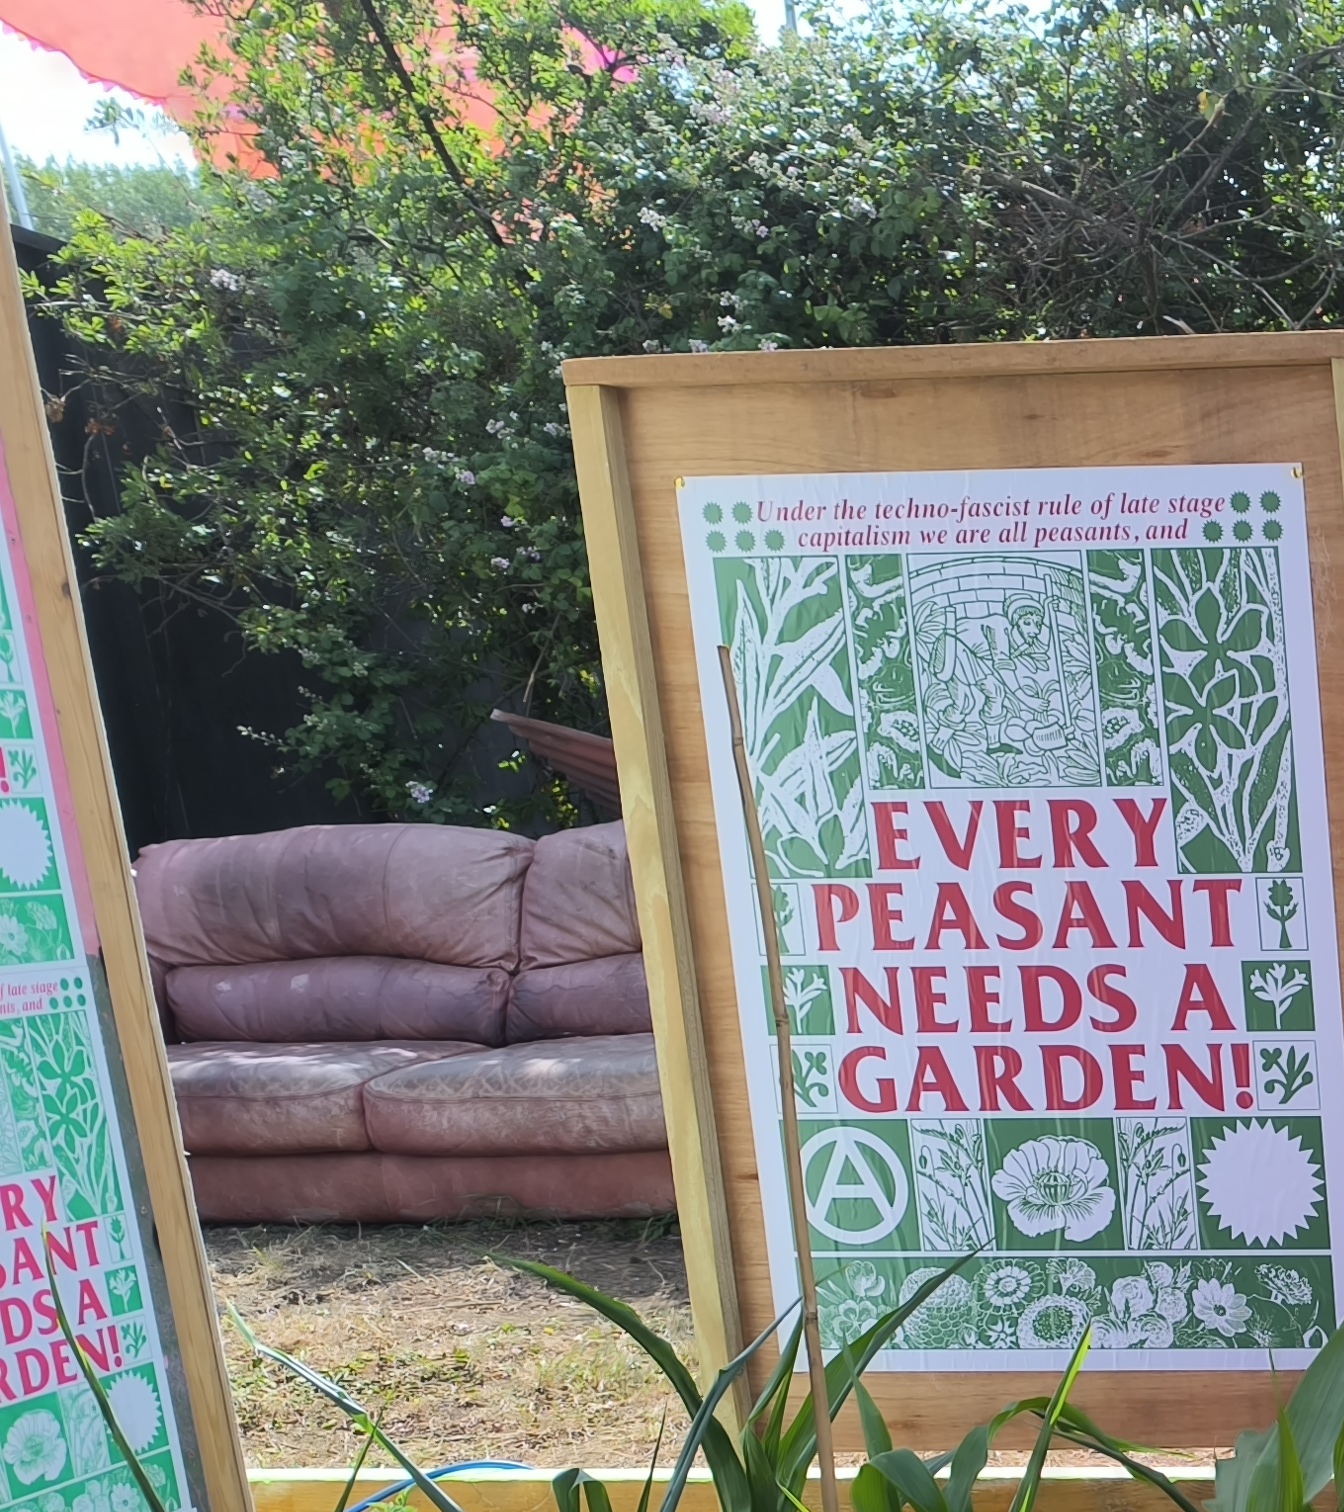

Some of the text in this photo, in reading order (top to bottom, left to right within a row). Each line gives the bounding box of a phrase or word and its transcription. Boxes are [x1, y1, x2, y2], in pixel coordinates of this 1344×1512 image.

[757, 492, 1226, 523] Under the techno-fascist rule of late stage
[798, 518, 1189, 552] capitalism we are all peasants, and
[871, 798, 1167, 871] EVERY
[811, 878, 1242, 952] PEASANT
[22, 996, 44, 1012] and
[838, 962, 1237, 1035] NEEDS A
[837, 1042, 1255, 1113] GARDEN!
[78, 1278, 108, 1325] A
[0, 1325, 122, 1401] DEN!
